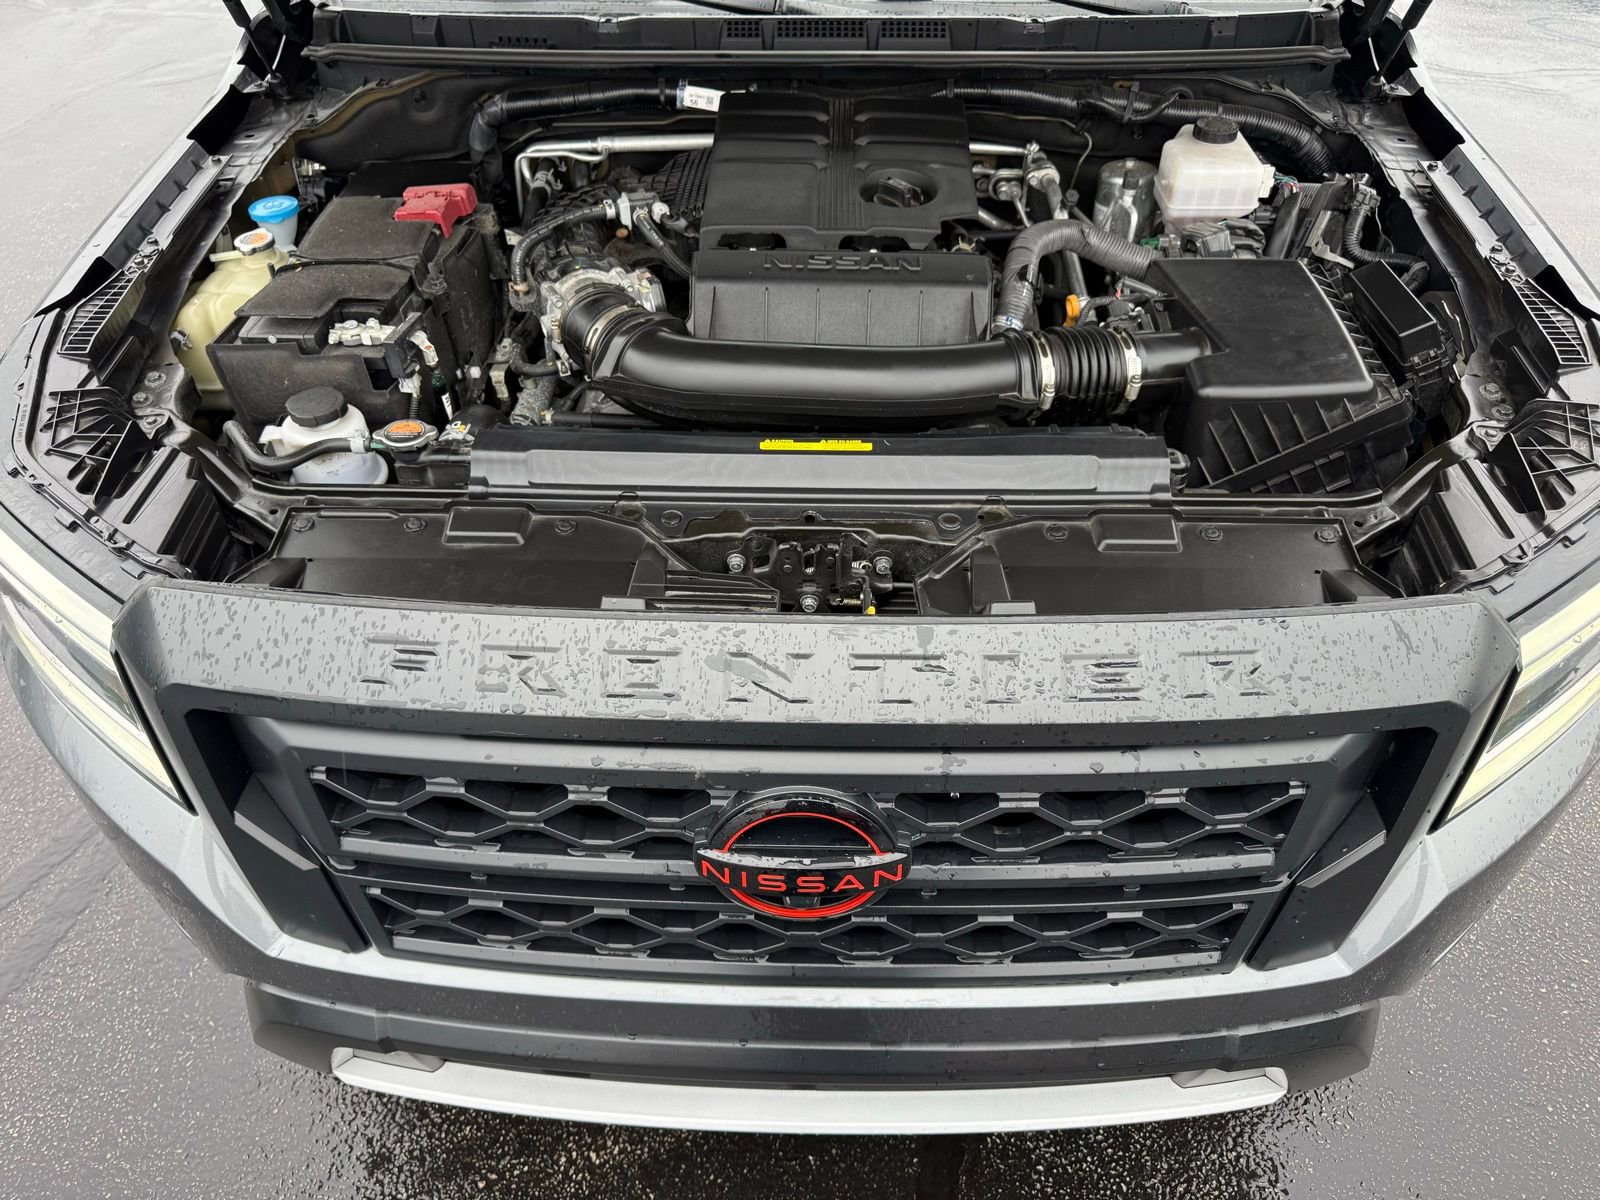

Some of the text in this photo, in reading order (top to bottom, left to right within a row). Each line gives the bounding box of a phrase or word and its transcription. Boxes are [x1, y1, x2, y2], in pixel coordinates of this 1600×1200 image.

[763, 253, 921, 271] NISSAN
[359, 636, 1276, 704] FRONTIER
[701, 859, 903, 893] NISSAN
